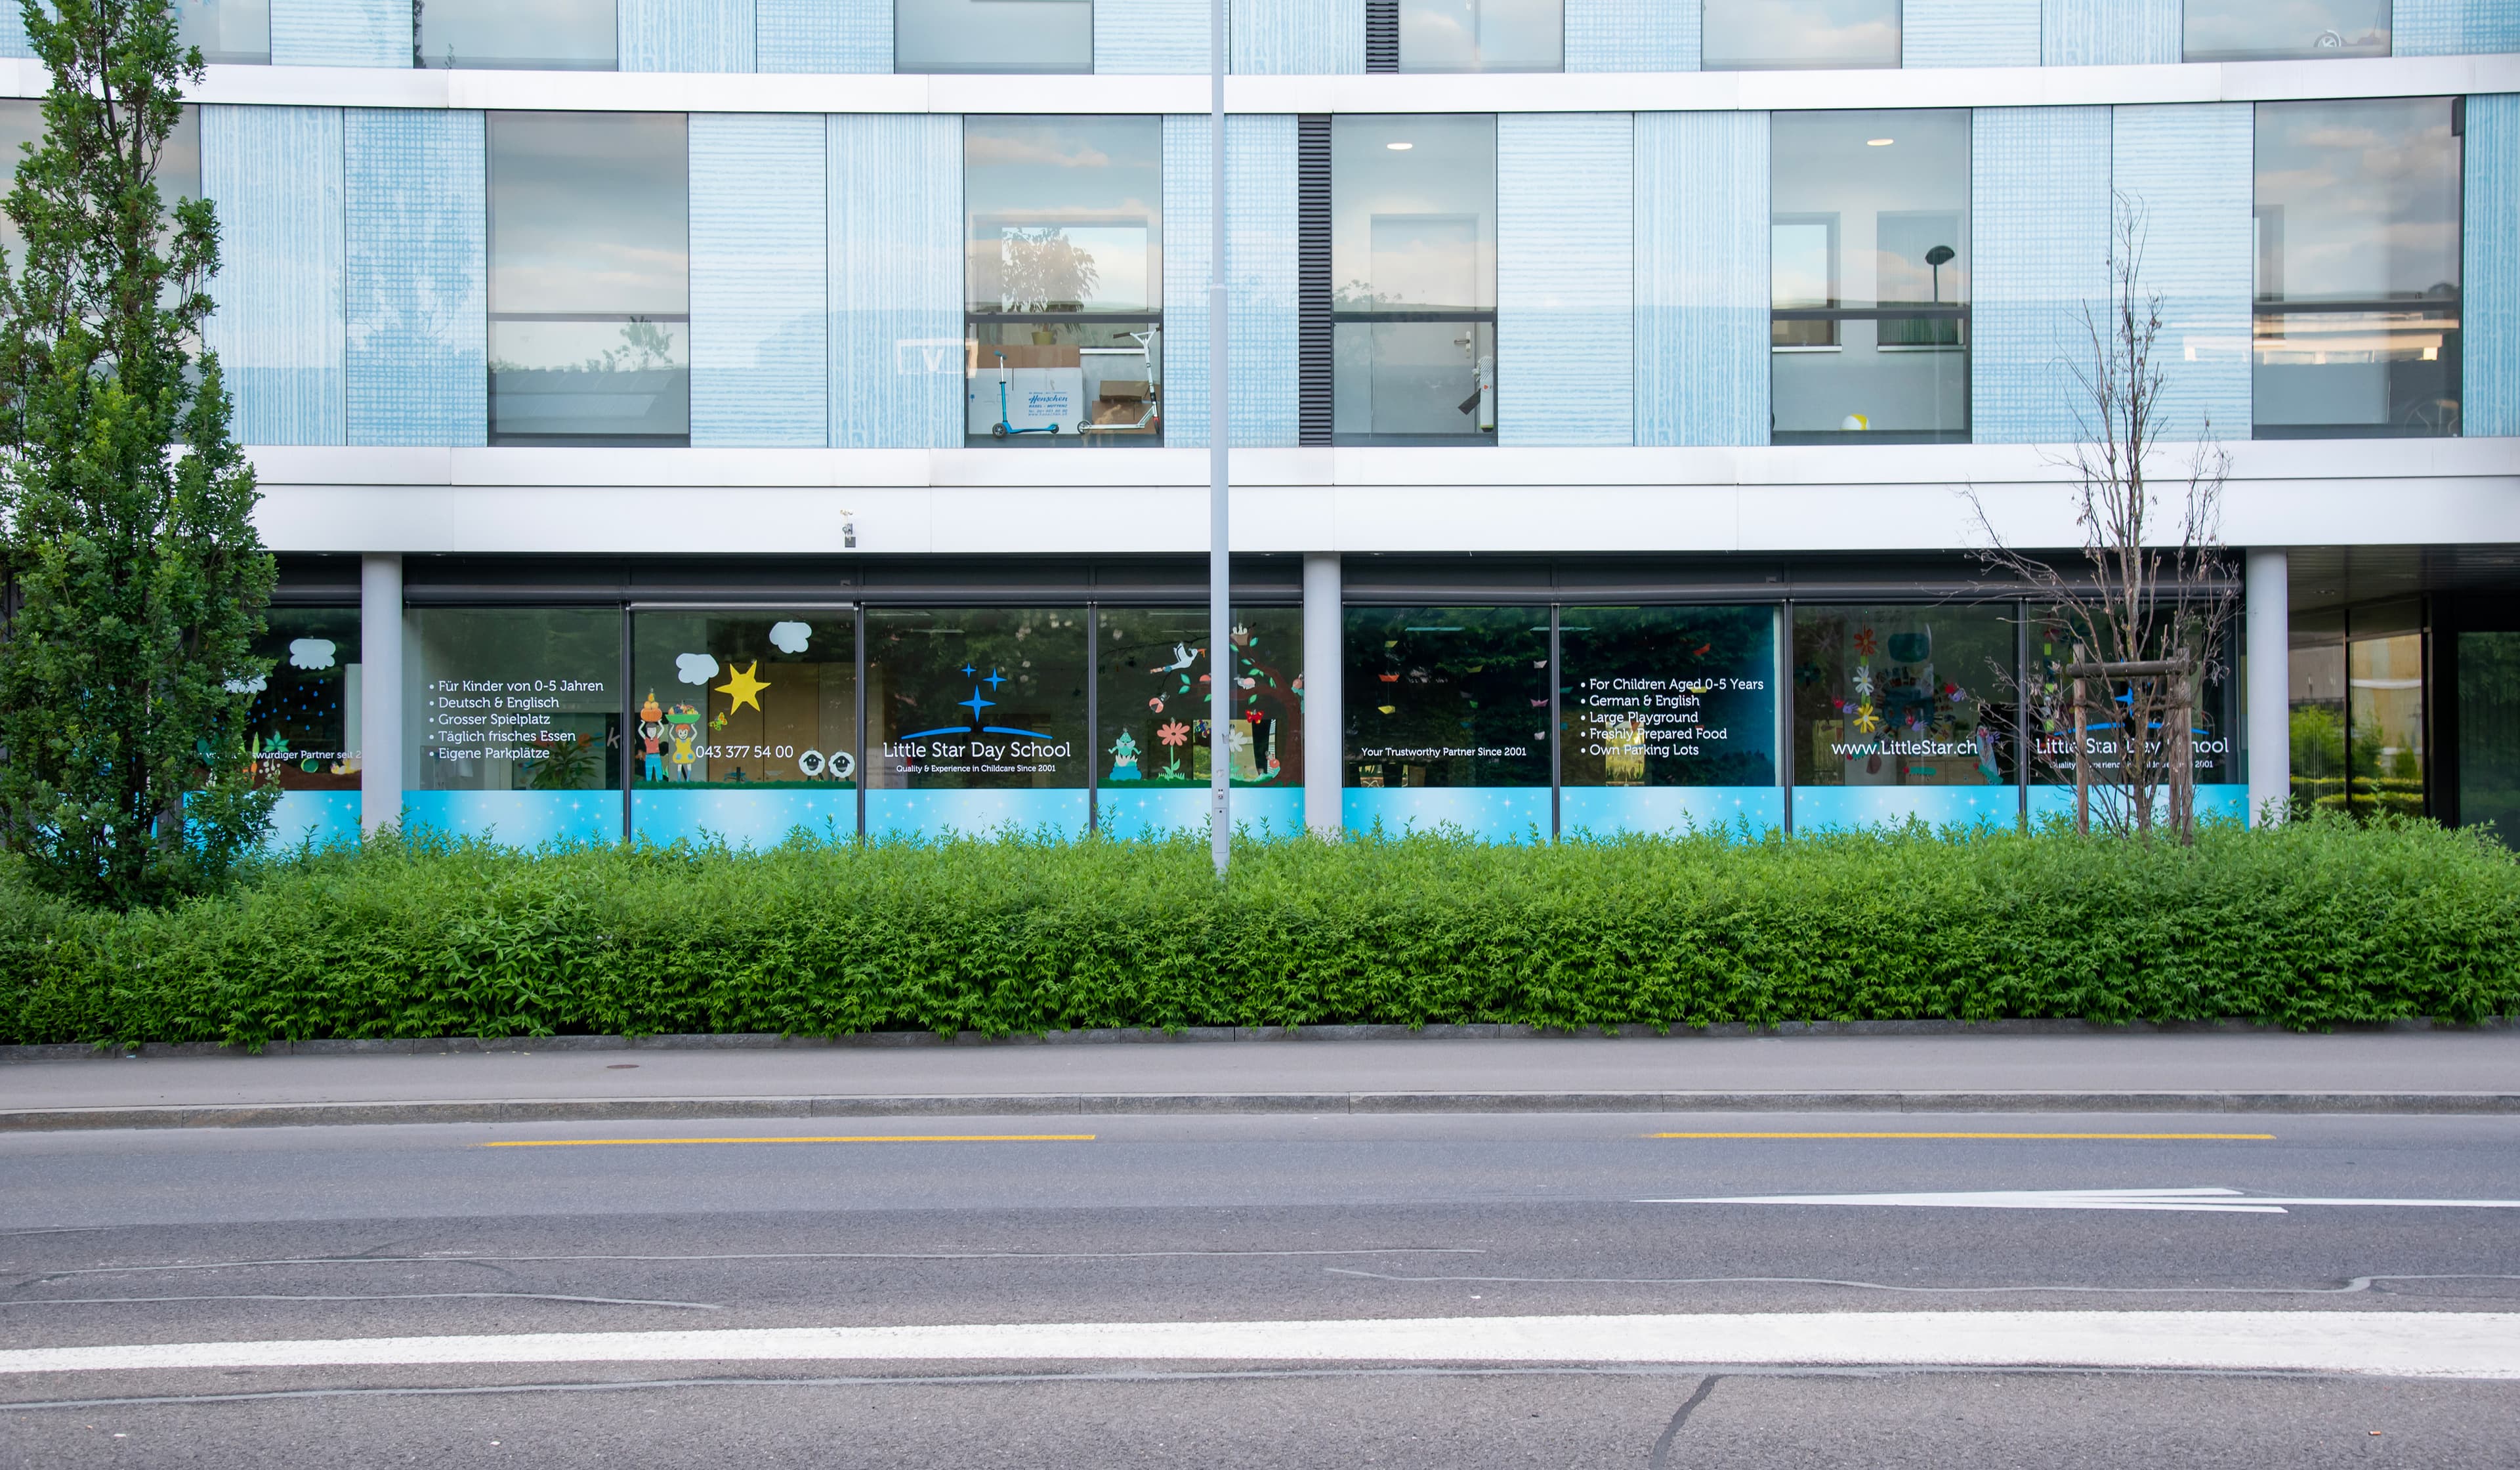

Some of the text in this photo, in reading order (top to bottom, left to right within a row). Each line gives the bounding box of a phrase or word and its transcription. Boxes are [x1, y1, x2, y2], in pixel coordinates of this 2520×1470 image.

[439, 681, 459, 691] Für
[463, 681, 503, 691] Kinder
[535, 681, 556, 691] 0-5
[560, 681, 603, 691] Jahren
[1590, 679, 1763, 692] For Children Aged 0-5 Years
[439, 697, 559, 710] Deutsch & Englisch
[1590, 695, 1700, 708] German & English
[439, 714, 550, 726] Grosser Spielplatz
[1590, 711, 1698, 724] Large Playground
[438, 731, 485, 744] Täglich
[489, 730, 536, 741] frisches
[541, 730, 576, 741] Essen
[1590, 728, 1727, 742] Freshly Prepared Food
[439, 747, 549, 761] Eigene Parkplätze
[696, 746, 793, 758] 043 377 54 00
[883, 742, 1070, 761] Little Star Day School
[1385, 747, 1440, 758] Trustworthy
[1590, 744, 1698, 757] Own Parking Lots
[1832, 740, 1977, 755] www.LittleStar.ch
